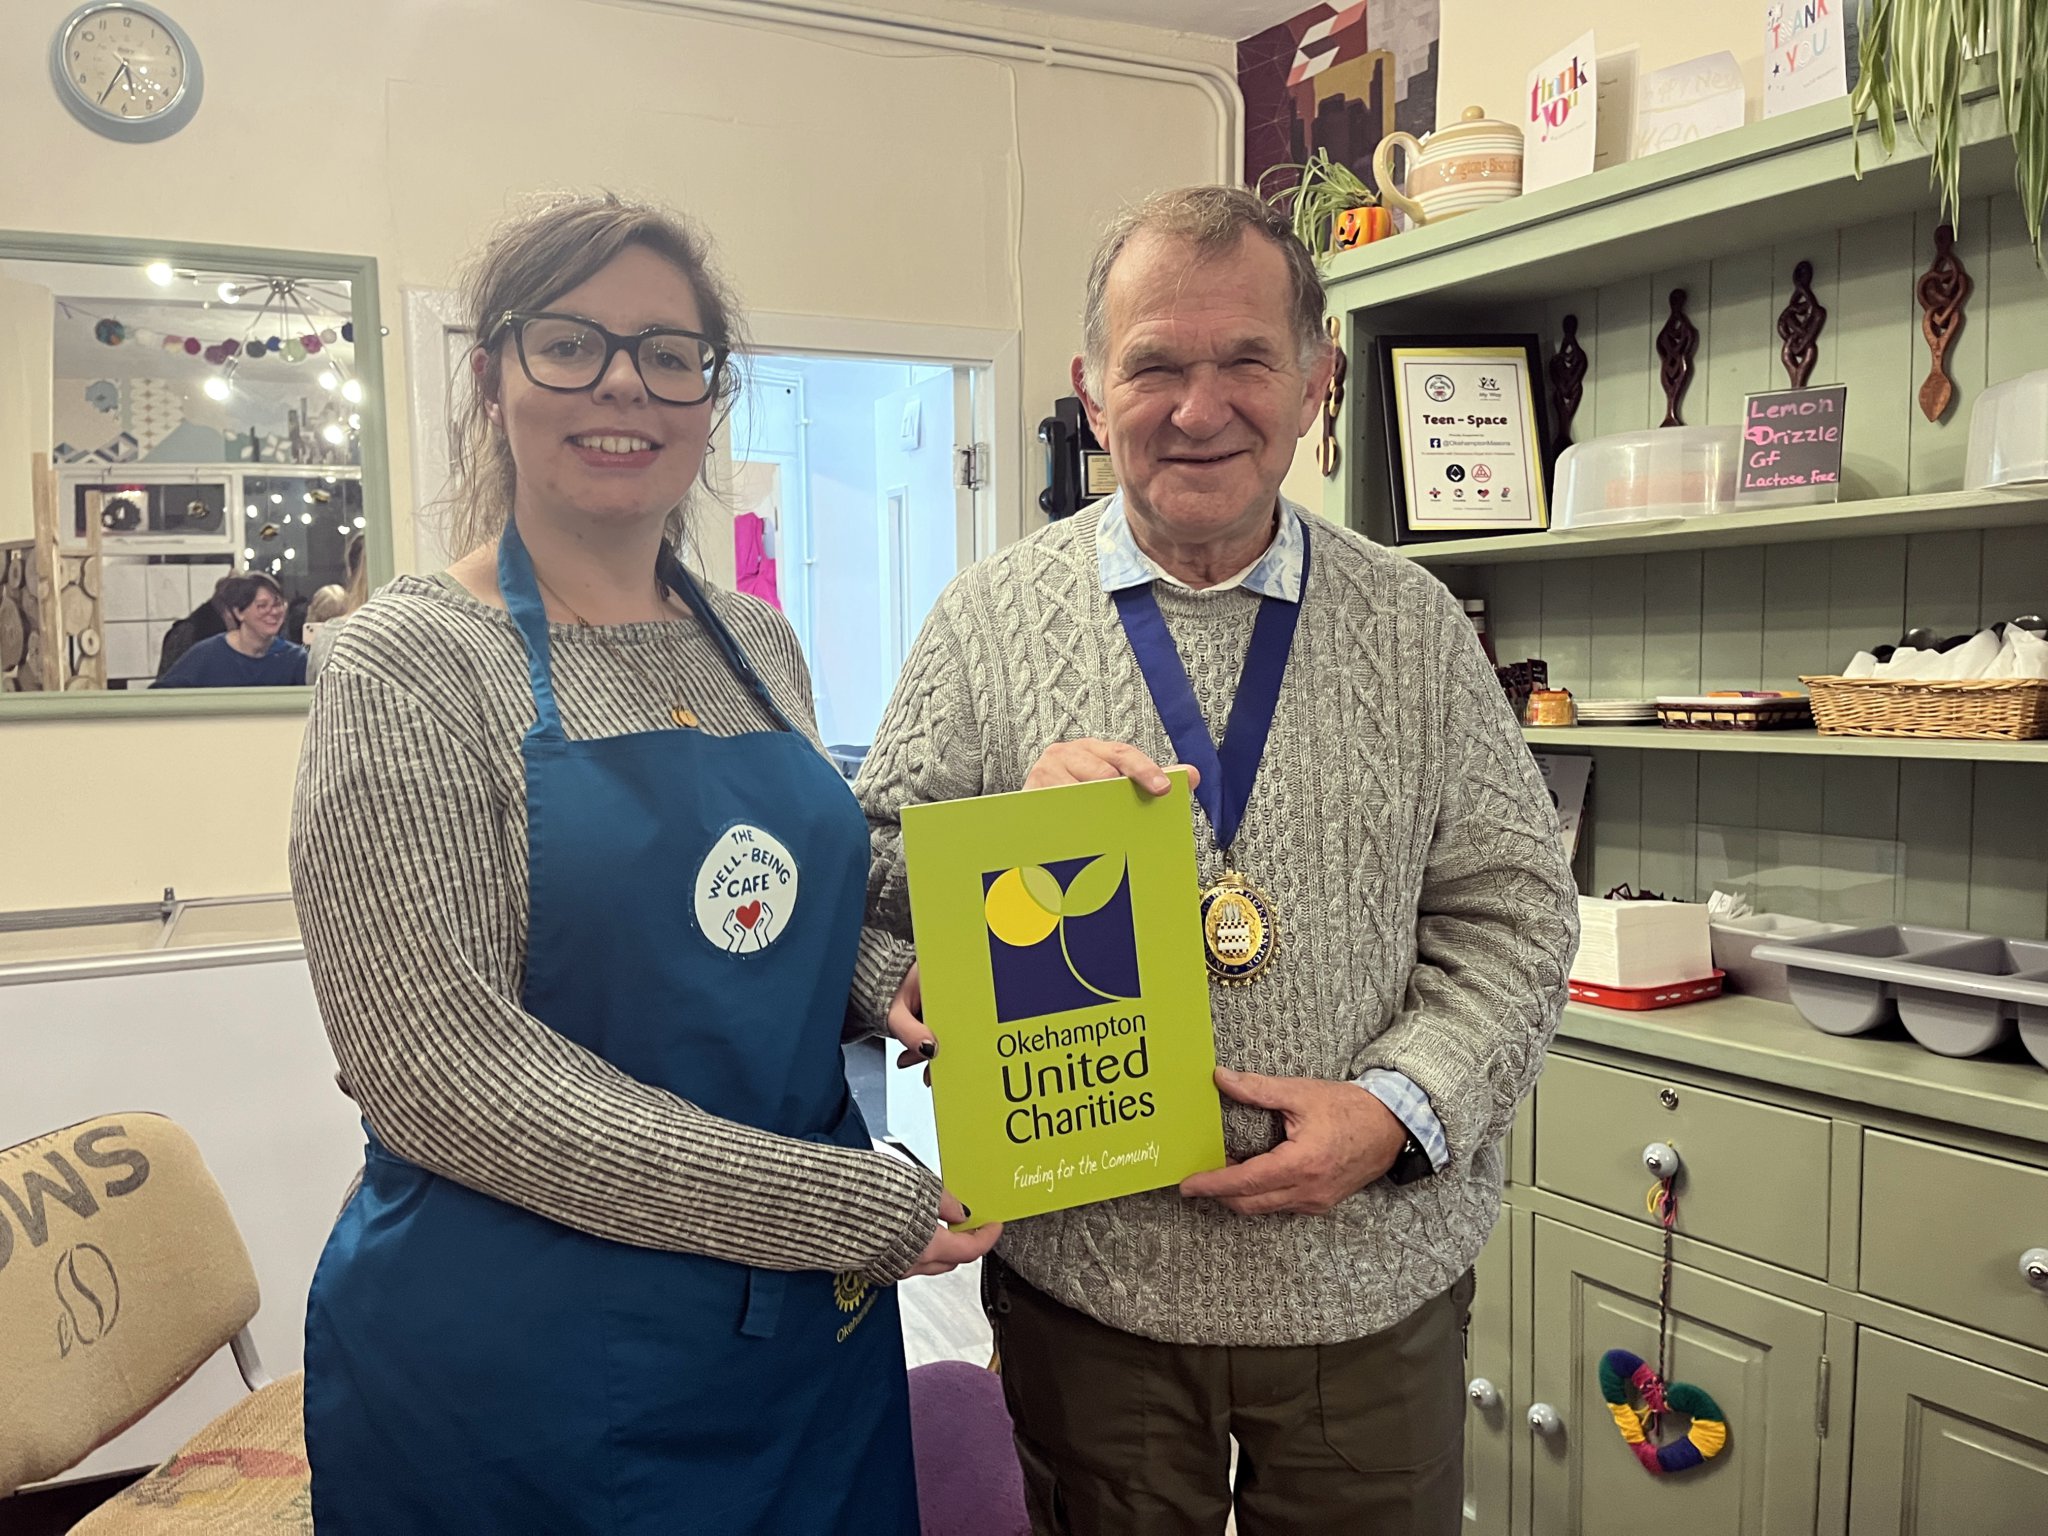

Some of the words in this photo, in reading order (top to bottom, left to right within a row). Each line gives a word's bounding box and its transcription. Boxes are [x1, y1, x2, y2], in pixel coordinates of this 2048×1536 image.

[1531, 55, 1588, 122] thank
[1541, 90, 1579, 142] you
[1423, 415, 1455, 425] Teen
[1467, 415, 1508, 428] Space
[1751, 398, 1833, 418] Lemon
[1753, 426, 1838, 445] Drizzle
[1745, 472, 1807, 488] Lactose
[731, 829, 755, 845] THE
[727, 873, 769, 898] CAFE
[997, 1014, 1146, 1058] Okehampton
[1002, 1036, 1149, 1103] United
[1006, 1091, 1155, 1144] Charities
[1014, 1165, 1054, 1193] Funding
[1057, 1159, 1075, 1180] for
[1079, 1154, 1098, 1174] the
[1101, 1140, 1160, 1167] Community
